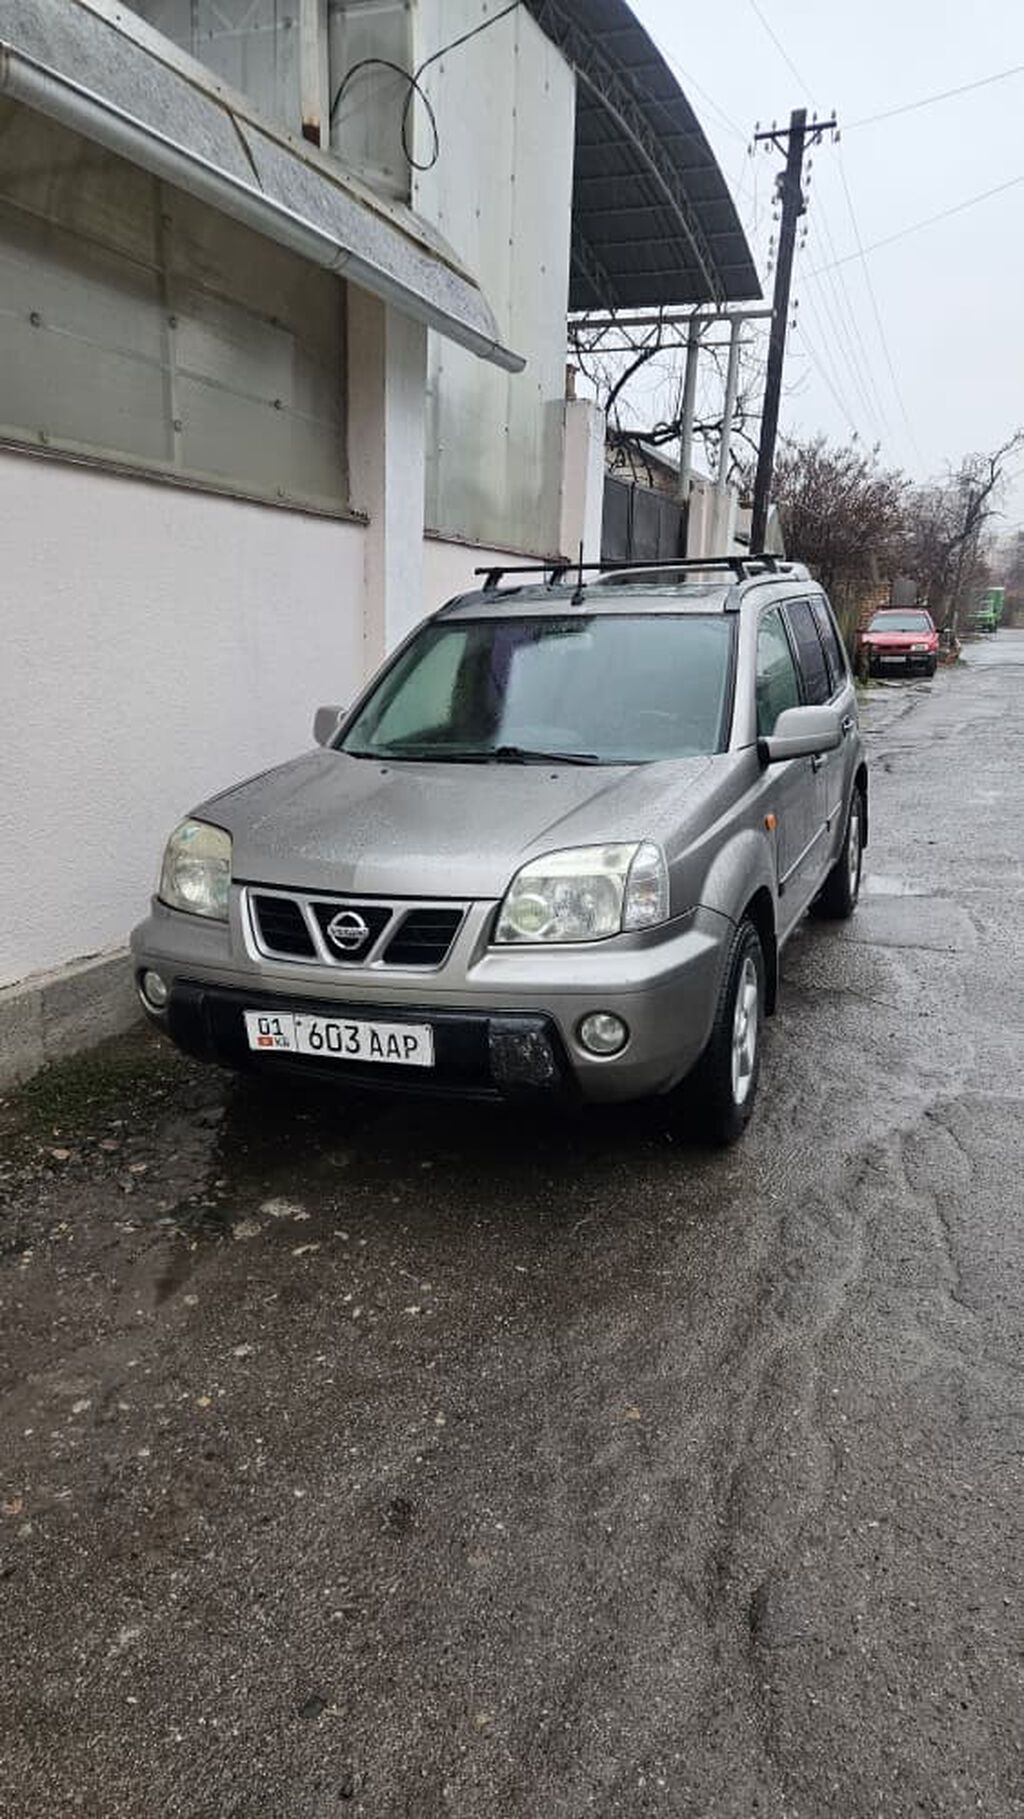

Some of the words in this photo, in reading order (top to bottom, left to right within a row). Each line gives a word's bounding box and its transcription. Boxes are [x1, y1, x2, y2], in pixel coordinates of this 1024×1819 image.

[258, 1018, 283, 1036] 01
[308, 1023, 360, 1054] 603
[370, 1029, 418, 1059] AAP
